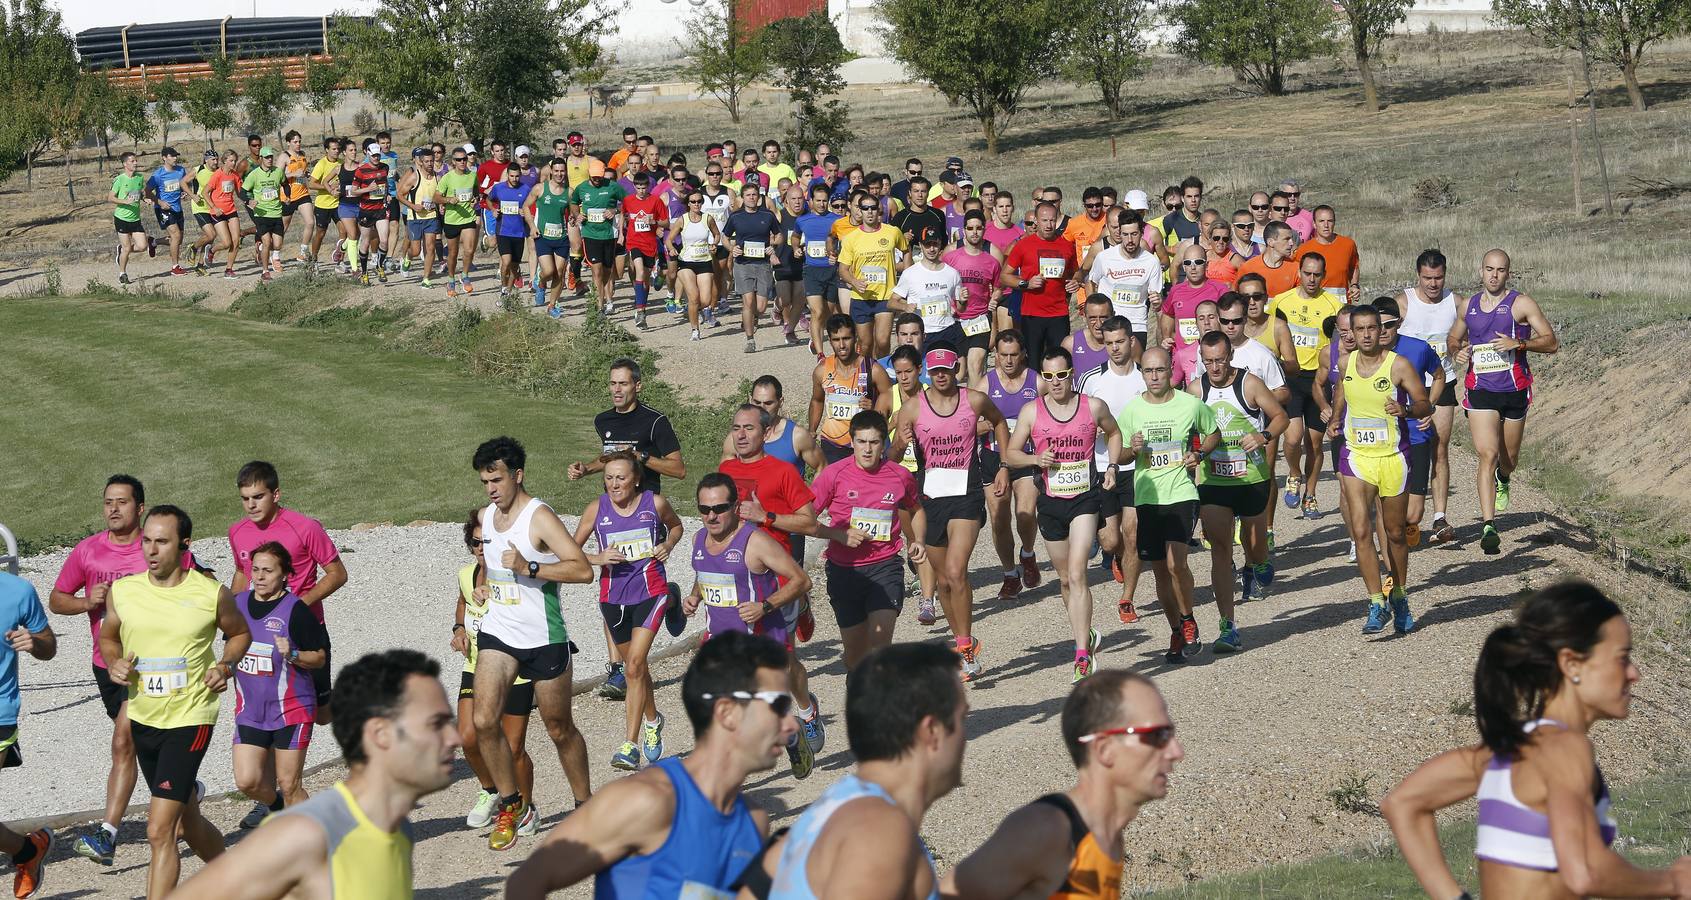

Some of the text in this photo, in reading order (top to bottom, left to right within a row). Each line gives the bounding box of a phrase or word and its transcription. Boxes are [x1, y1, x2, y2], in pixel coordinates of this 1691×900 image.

[1045, 266, 1058, 276] 145
[1106, 266, 1146, 278] Azucarera
[1117, 292, 1131, 302] 146
[928, 305, 937, 315] 37
[971, 324, 979, 333] 47
[1291, 334, 1307, 346] 124
[1480, 352, 1500, 363] 586
[833, 405, 850, 418] 287
[931, 433, 963, 445] Triatlón
[1046, 436, 1084, 448] Triatlón
[1357, 431, 1375, 443] 349
[931, 445, 964, 456] Pisuerga
[1053, 449, 1085, 461] suerga
[1062, 462, 1087, 471] balance
[1151, 454, 1169, 467] 308
[1216, 463, 1234, 476] 352
[1057, 471, 1081, 484] 536
[857, 521, 878, 538] 224
[705, 587, 721, 603] 125
[472, 619, 482, 632] 5
[148, 676, 164, 693] 44
